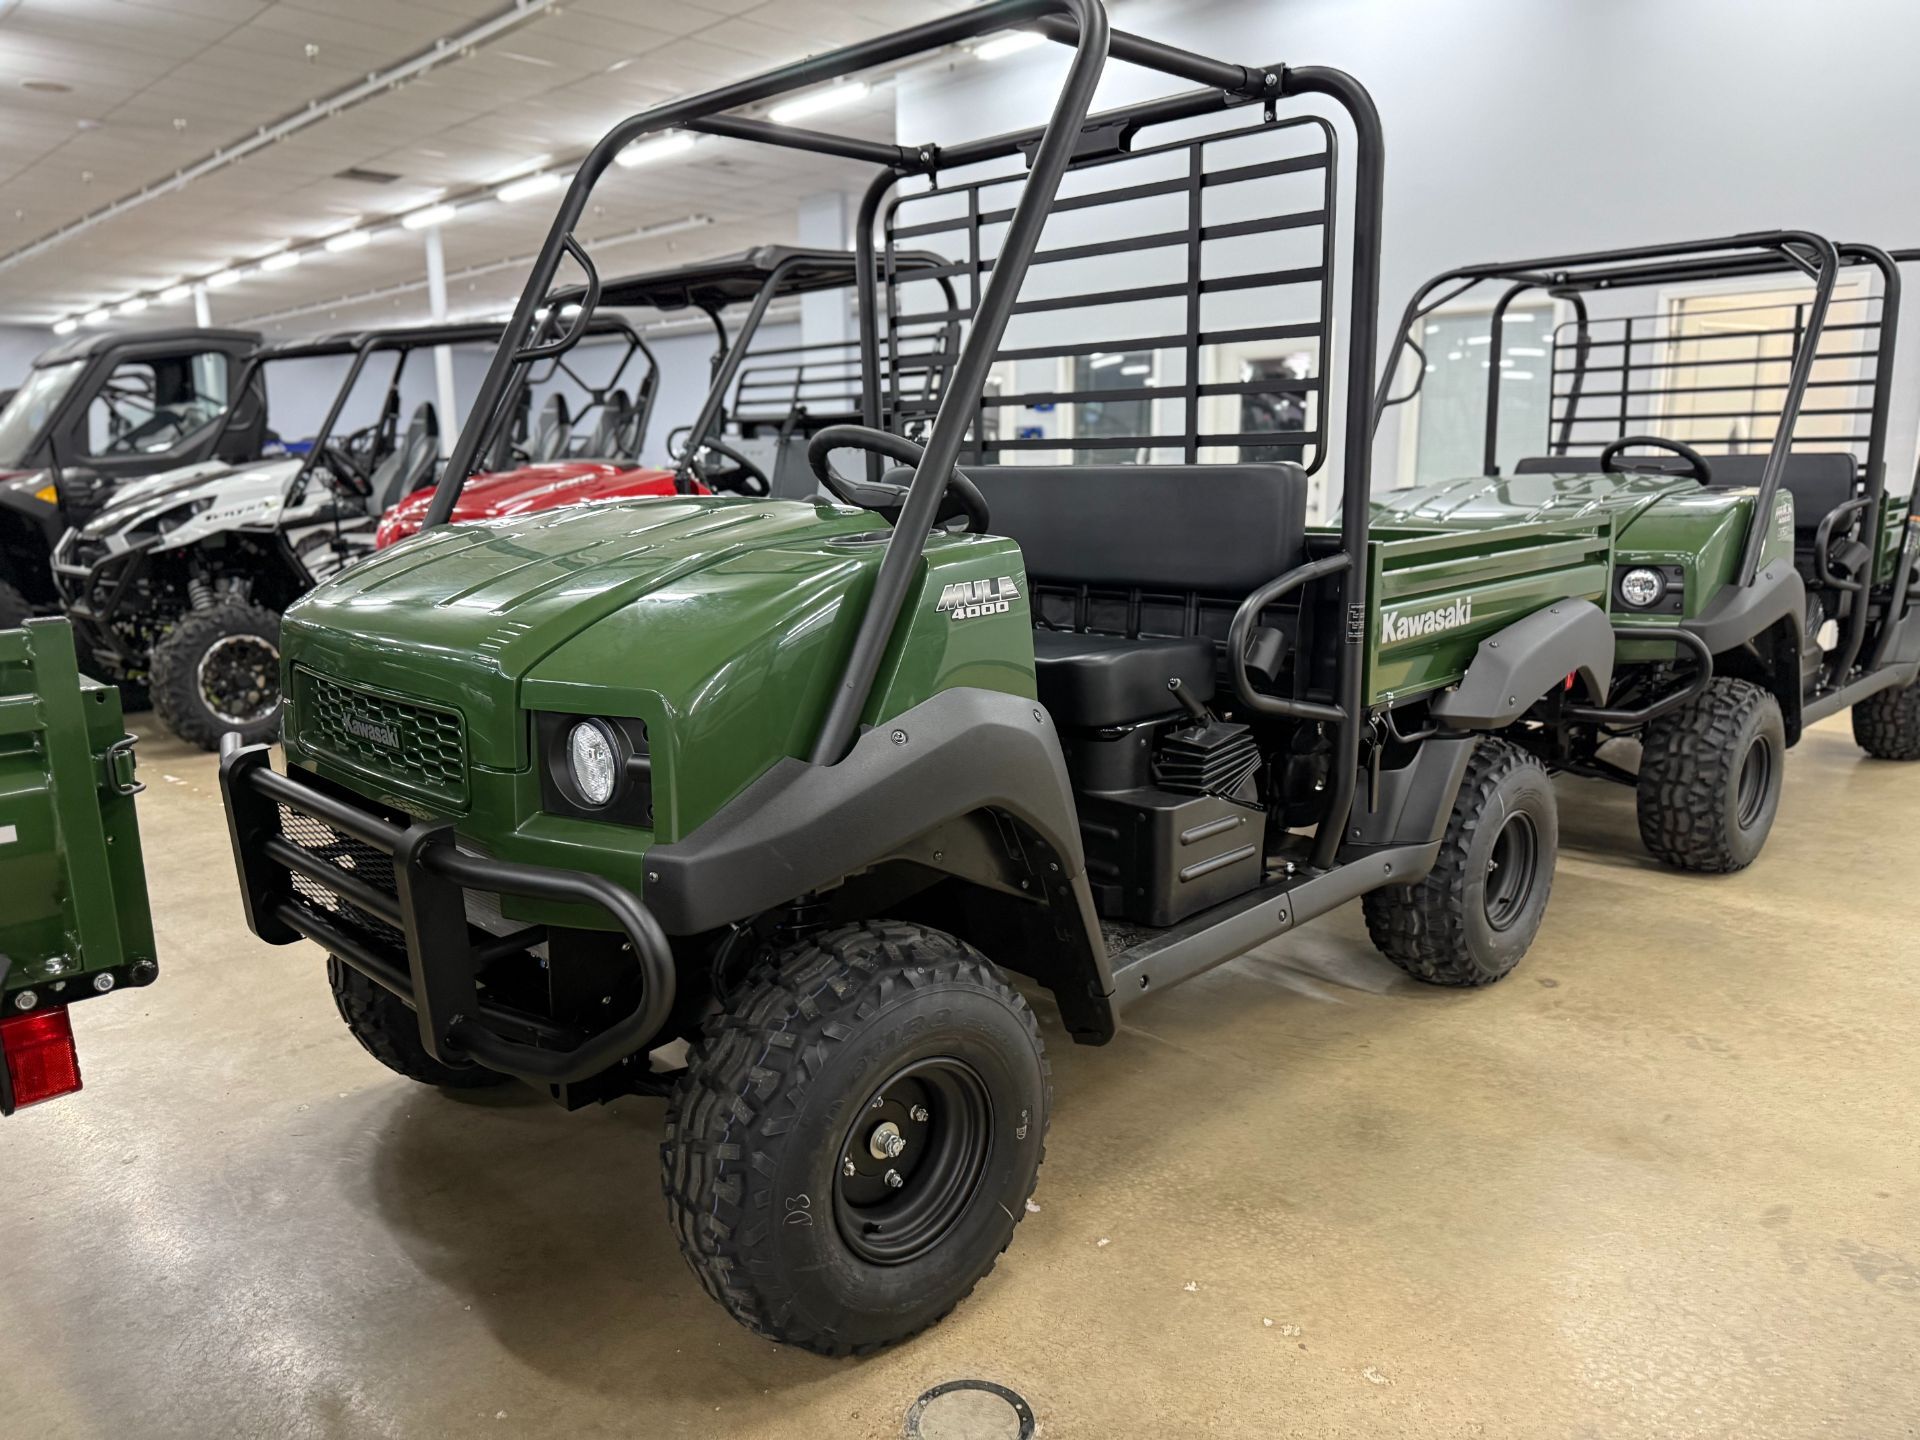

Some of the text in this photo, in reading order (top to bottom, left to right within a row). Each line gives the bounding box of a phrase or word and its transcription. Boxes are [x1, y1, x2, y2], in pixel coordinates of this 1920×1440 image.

[935, 576, 1022, 612] MULE
[951, 601, 1010, 621] 4000
[1381, 596, 1473, 644] Kawasaki
[342, 710, 400, 749] Kawasaki
